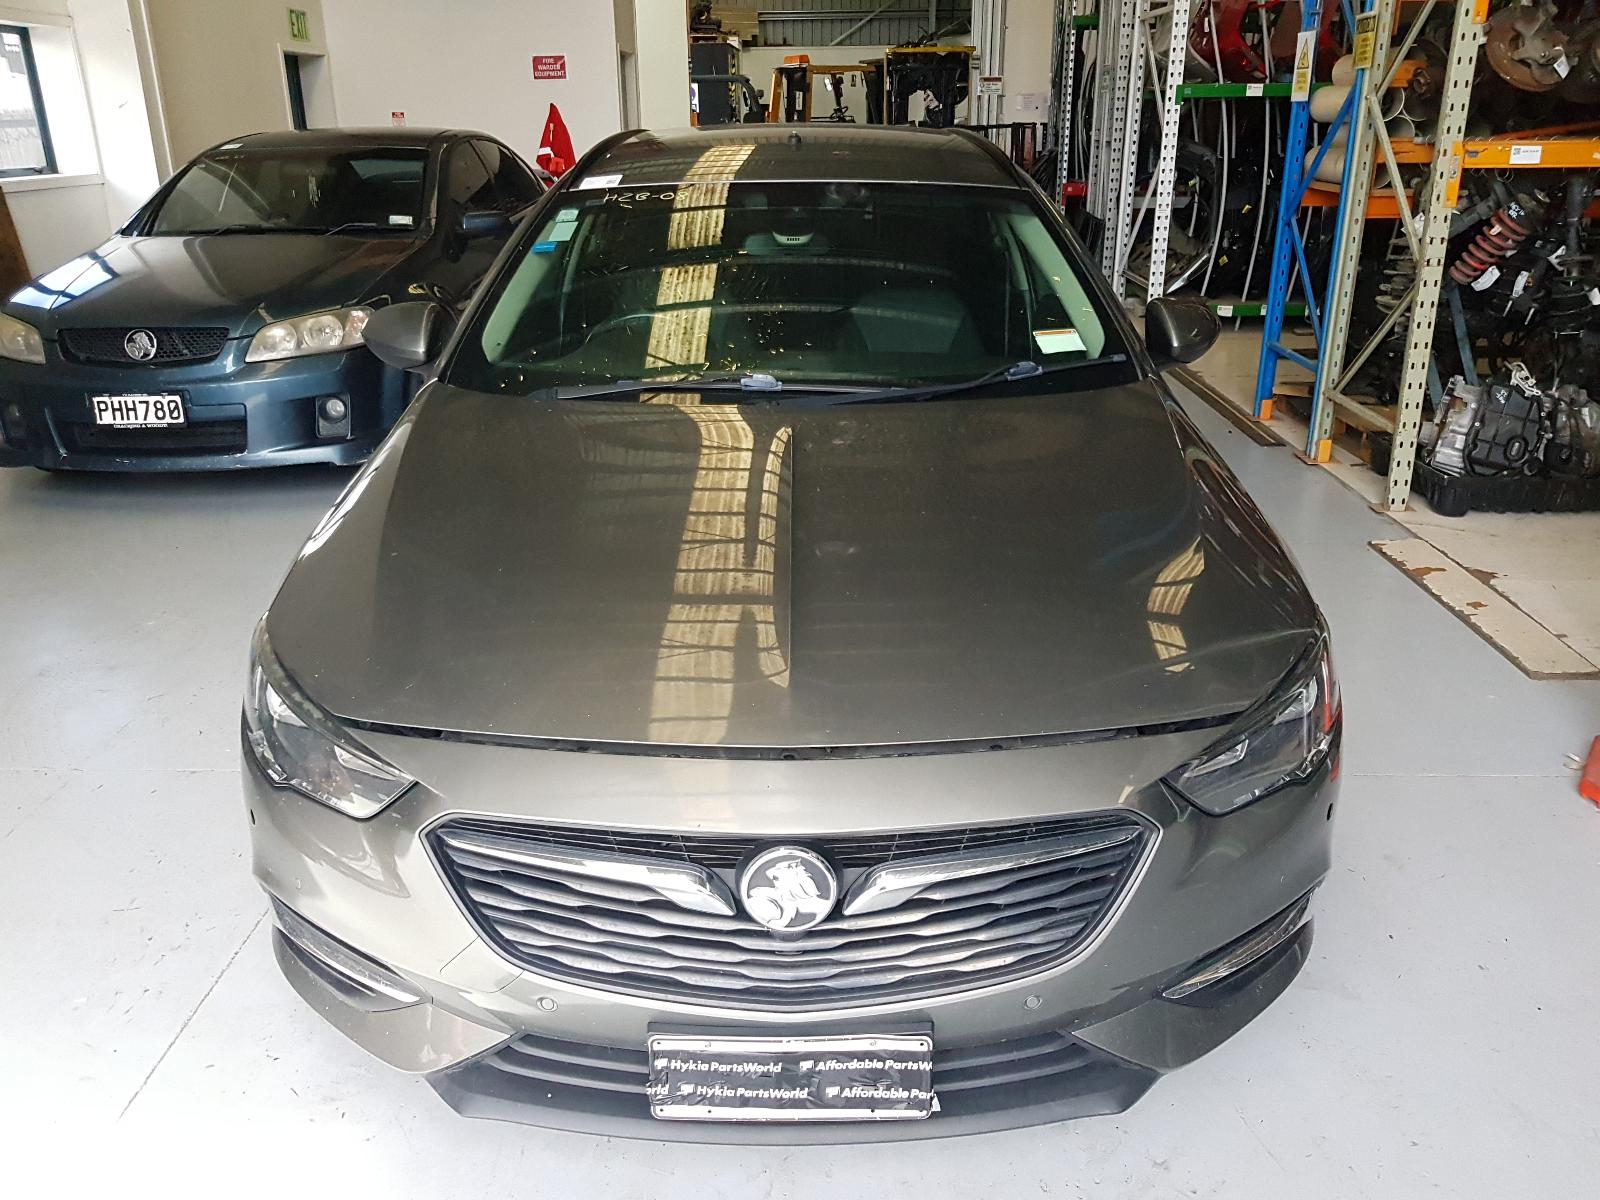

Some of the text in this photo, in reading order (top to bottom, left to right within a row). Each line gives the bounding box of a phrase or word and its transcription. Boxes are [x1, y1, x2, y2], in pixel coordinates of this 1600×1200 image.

[289, 9, 307, 40] EXIT
[96, 399, 181, 421] PHH780
[670, 1059, 709, 1072] Hykia
[710, 1062, 782, 1073] PartsWorld
[816, 1059, 884, 1070] Affordable
[696, 1086, 735, 1098] Hykia
[736, 1087, 809, 1099] PartsWorld
[841, 1087, 909, 1099] Affordable
